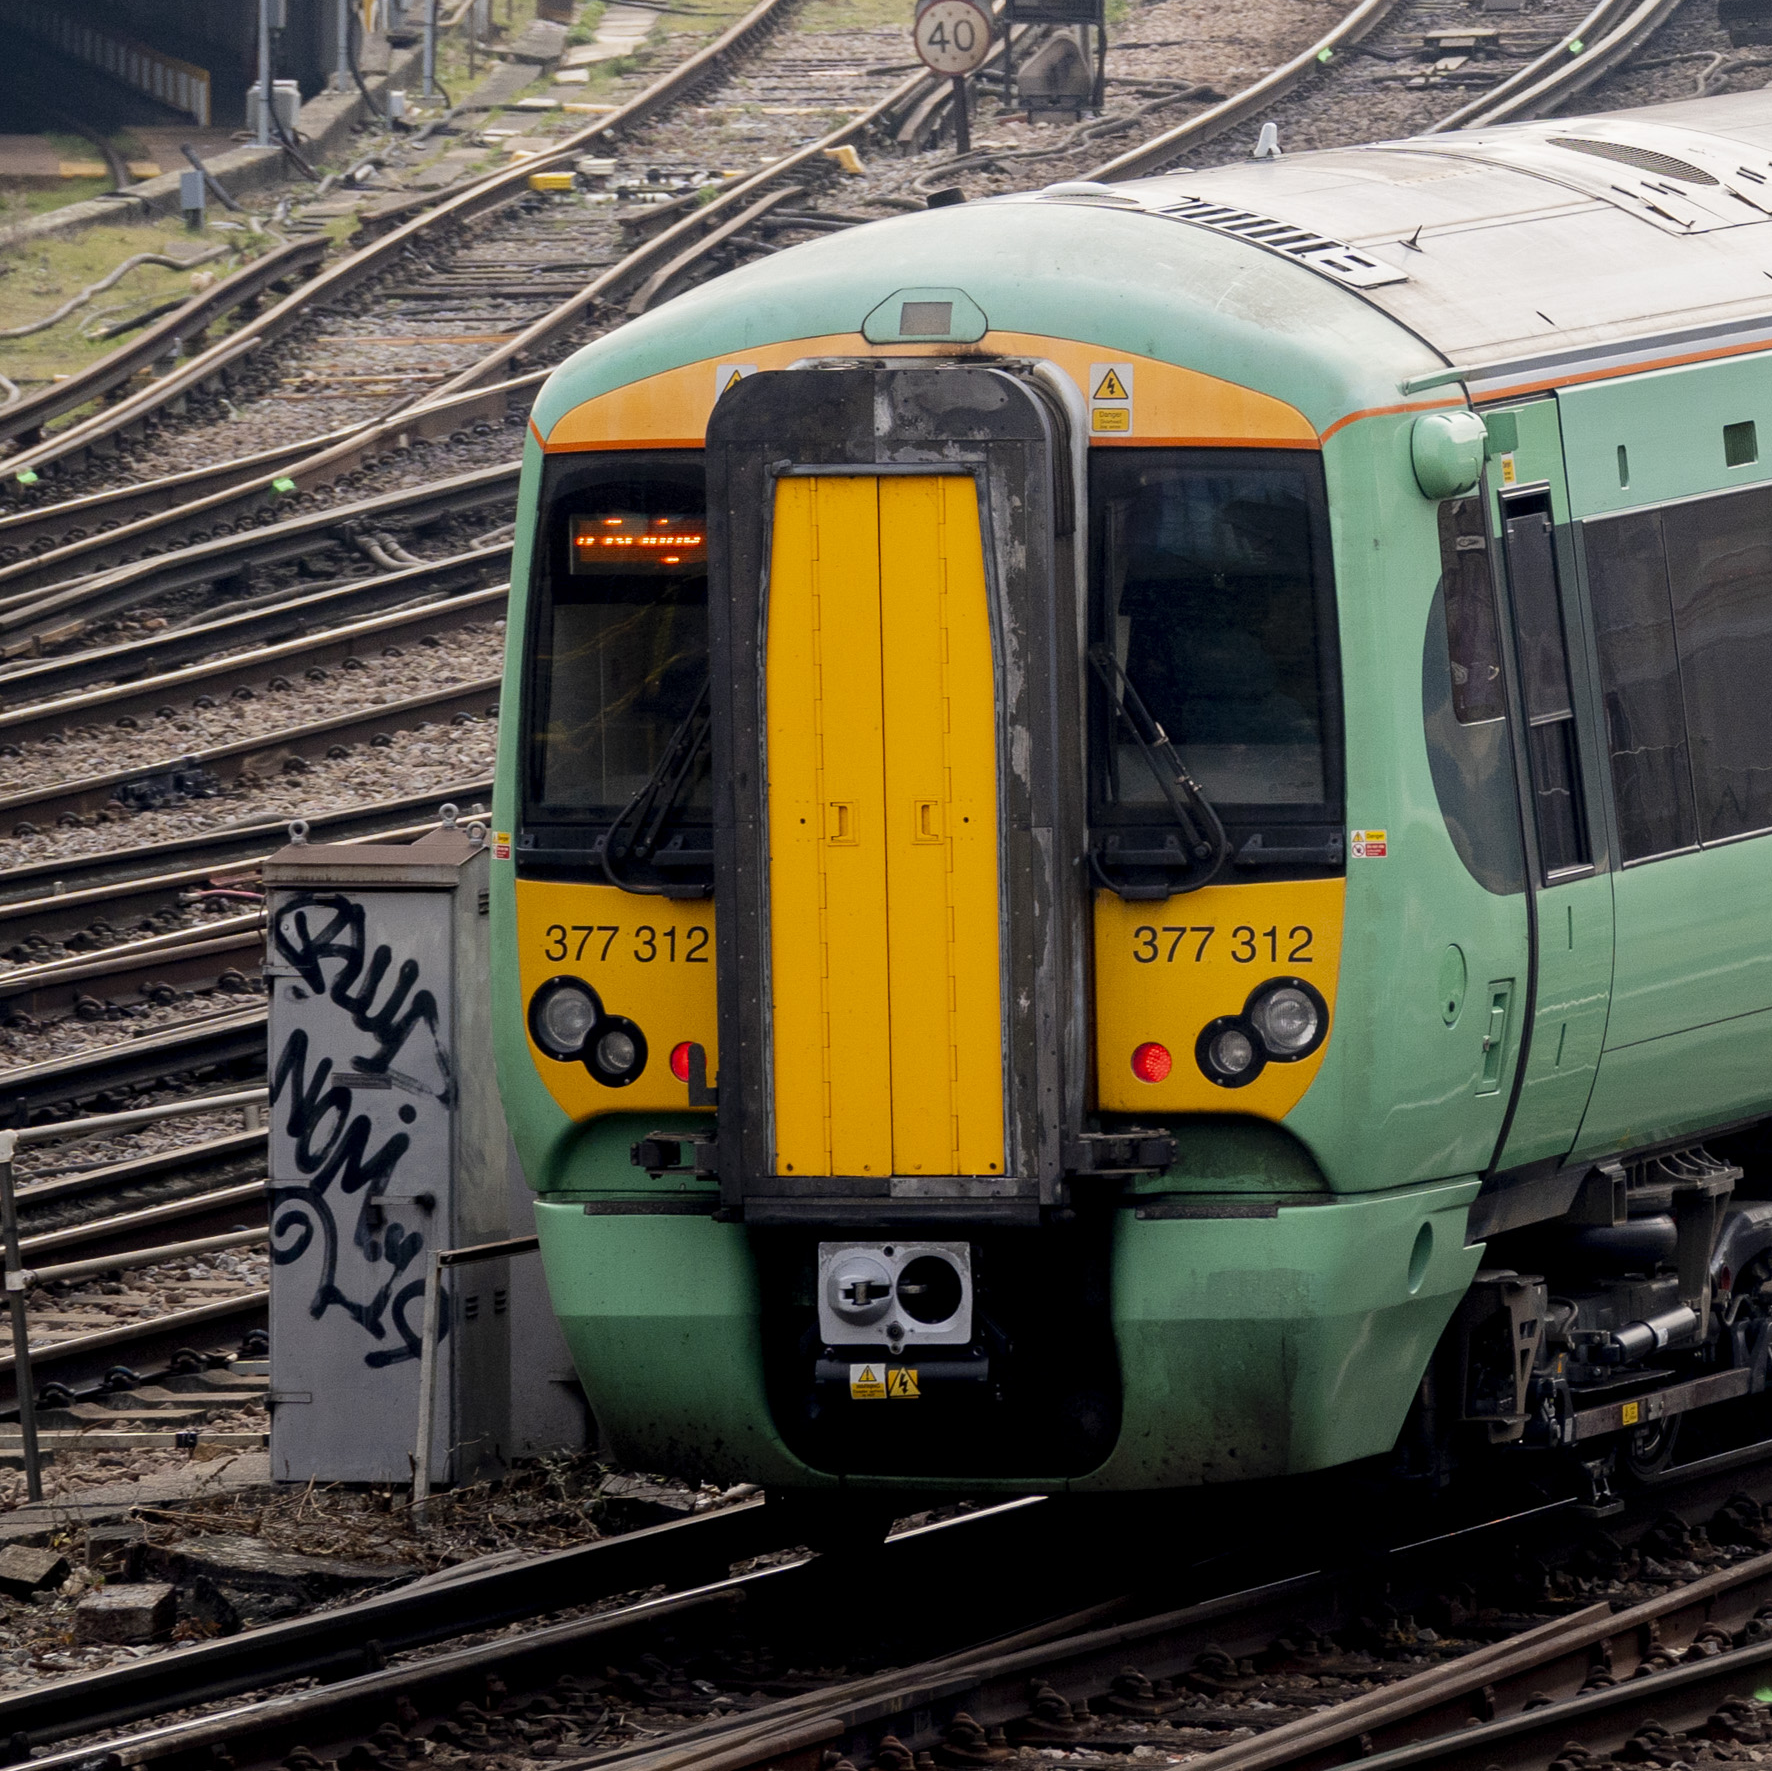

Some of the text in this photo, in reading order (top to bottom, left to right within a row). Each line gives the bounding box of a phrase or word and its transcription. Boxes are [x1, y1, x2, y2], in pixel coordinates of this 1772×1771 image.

[927, 19, 976, 54] 40
[544, 924, 710, 963] 377 312
[1133, 925, 1313, 964] 377 312
